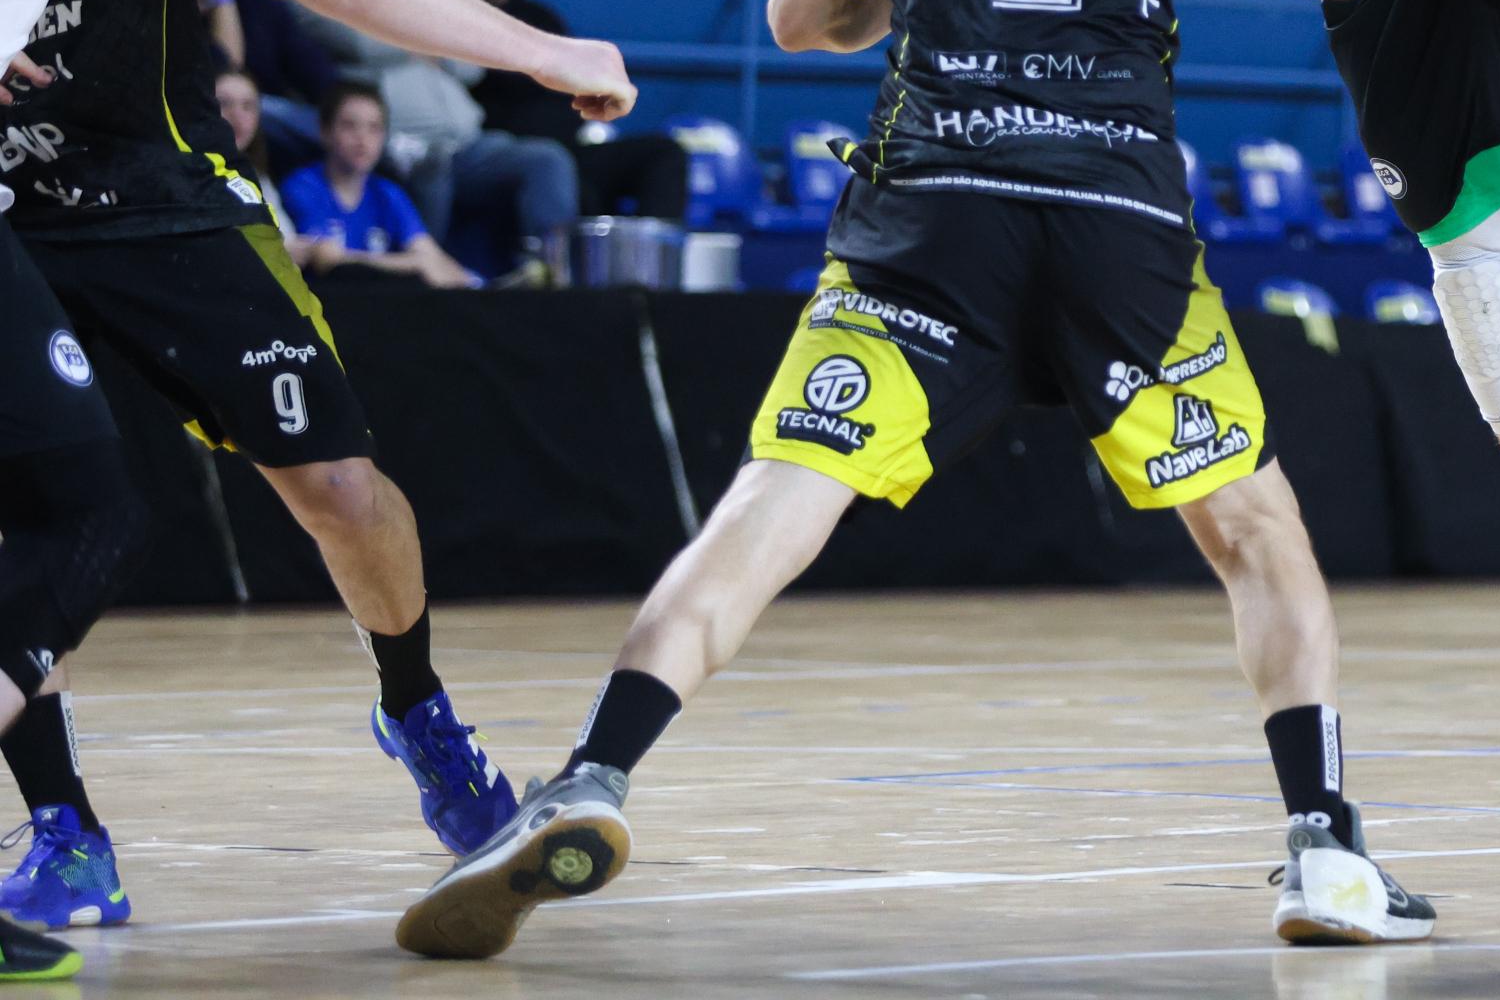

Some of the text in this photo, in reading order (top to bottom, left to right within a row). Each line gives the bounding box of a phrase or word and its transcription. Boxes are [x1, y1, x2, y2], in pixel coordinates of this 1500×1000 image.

[1013, 183, 1032, 193] QUE
[1033, 186, 1064, 197] NUNCA
[842, 293, 958, 346] VIDROTEC
[272, 372, 309, 435] 9
[778, 410, 863, 446] TECNAL
[1149, 427, 1250, 485] NaveLab
[1325, 720, 1337, 783] PROSOCKS
